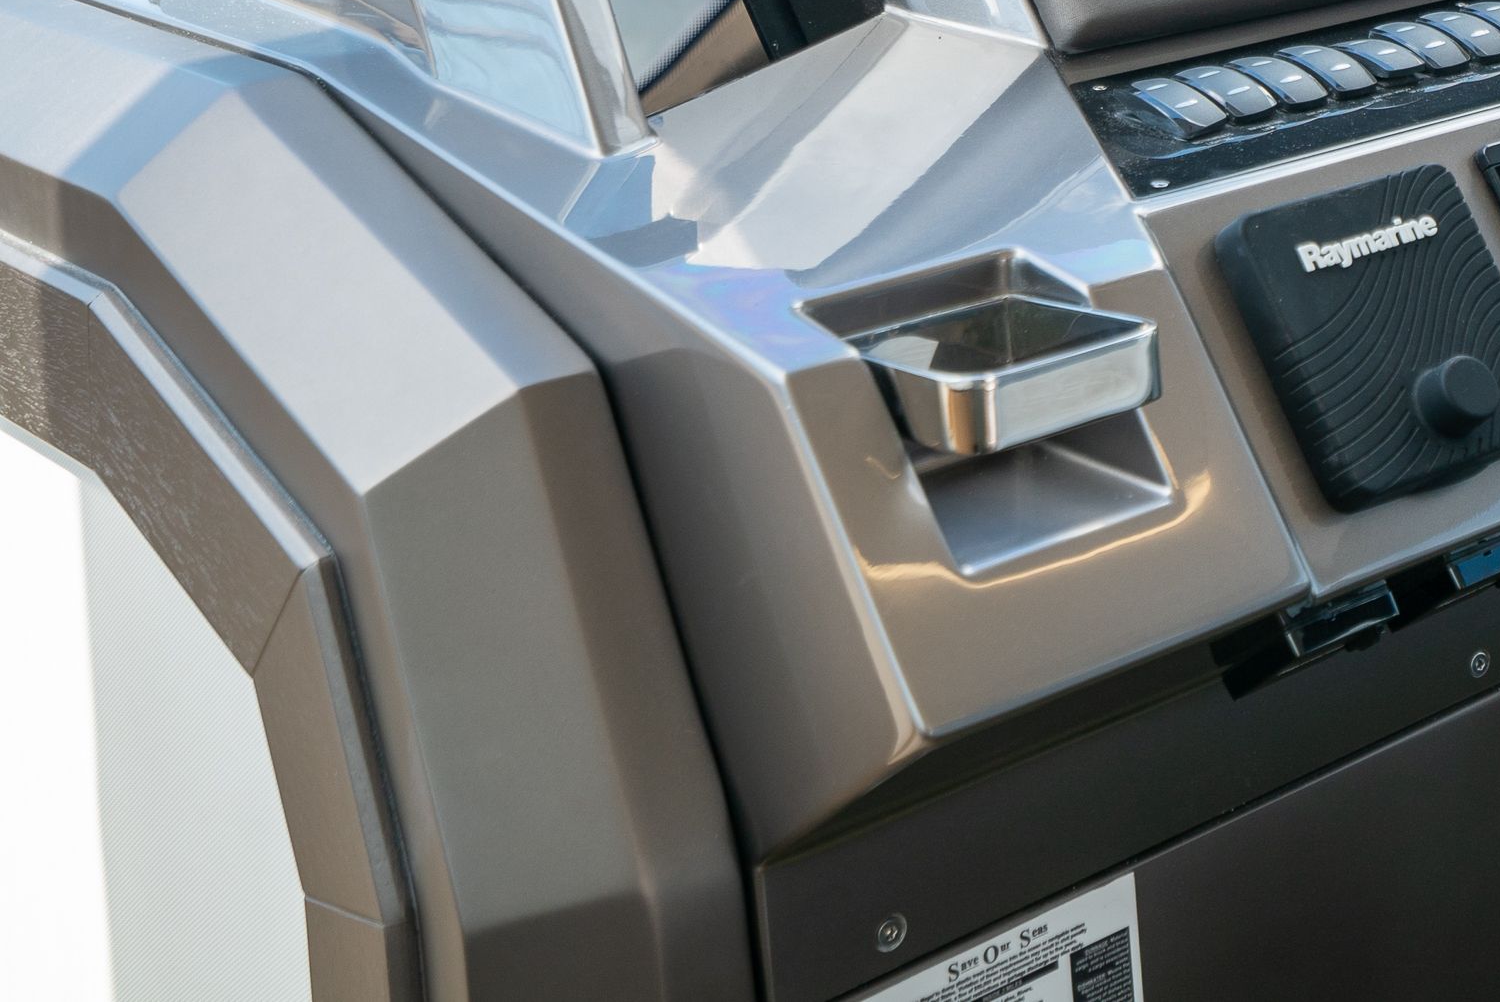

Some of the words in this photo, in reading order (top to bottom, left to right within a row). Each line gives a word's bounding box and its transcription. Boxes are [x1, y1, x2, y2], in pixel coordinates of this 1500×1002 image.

[1296, 216, 1438, 272] Raymarine
[948, 956, 980, 982] Save
[983, 942, 1012, 964] Our
[1020, 924, 1048, 948] Seas
